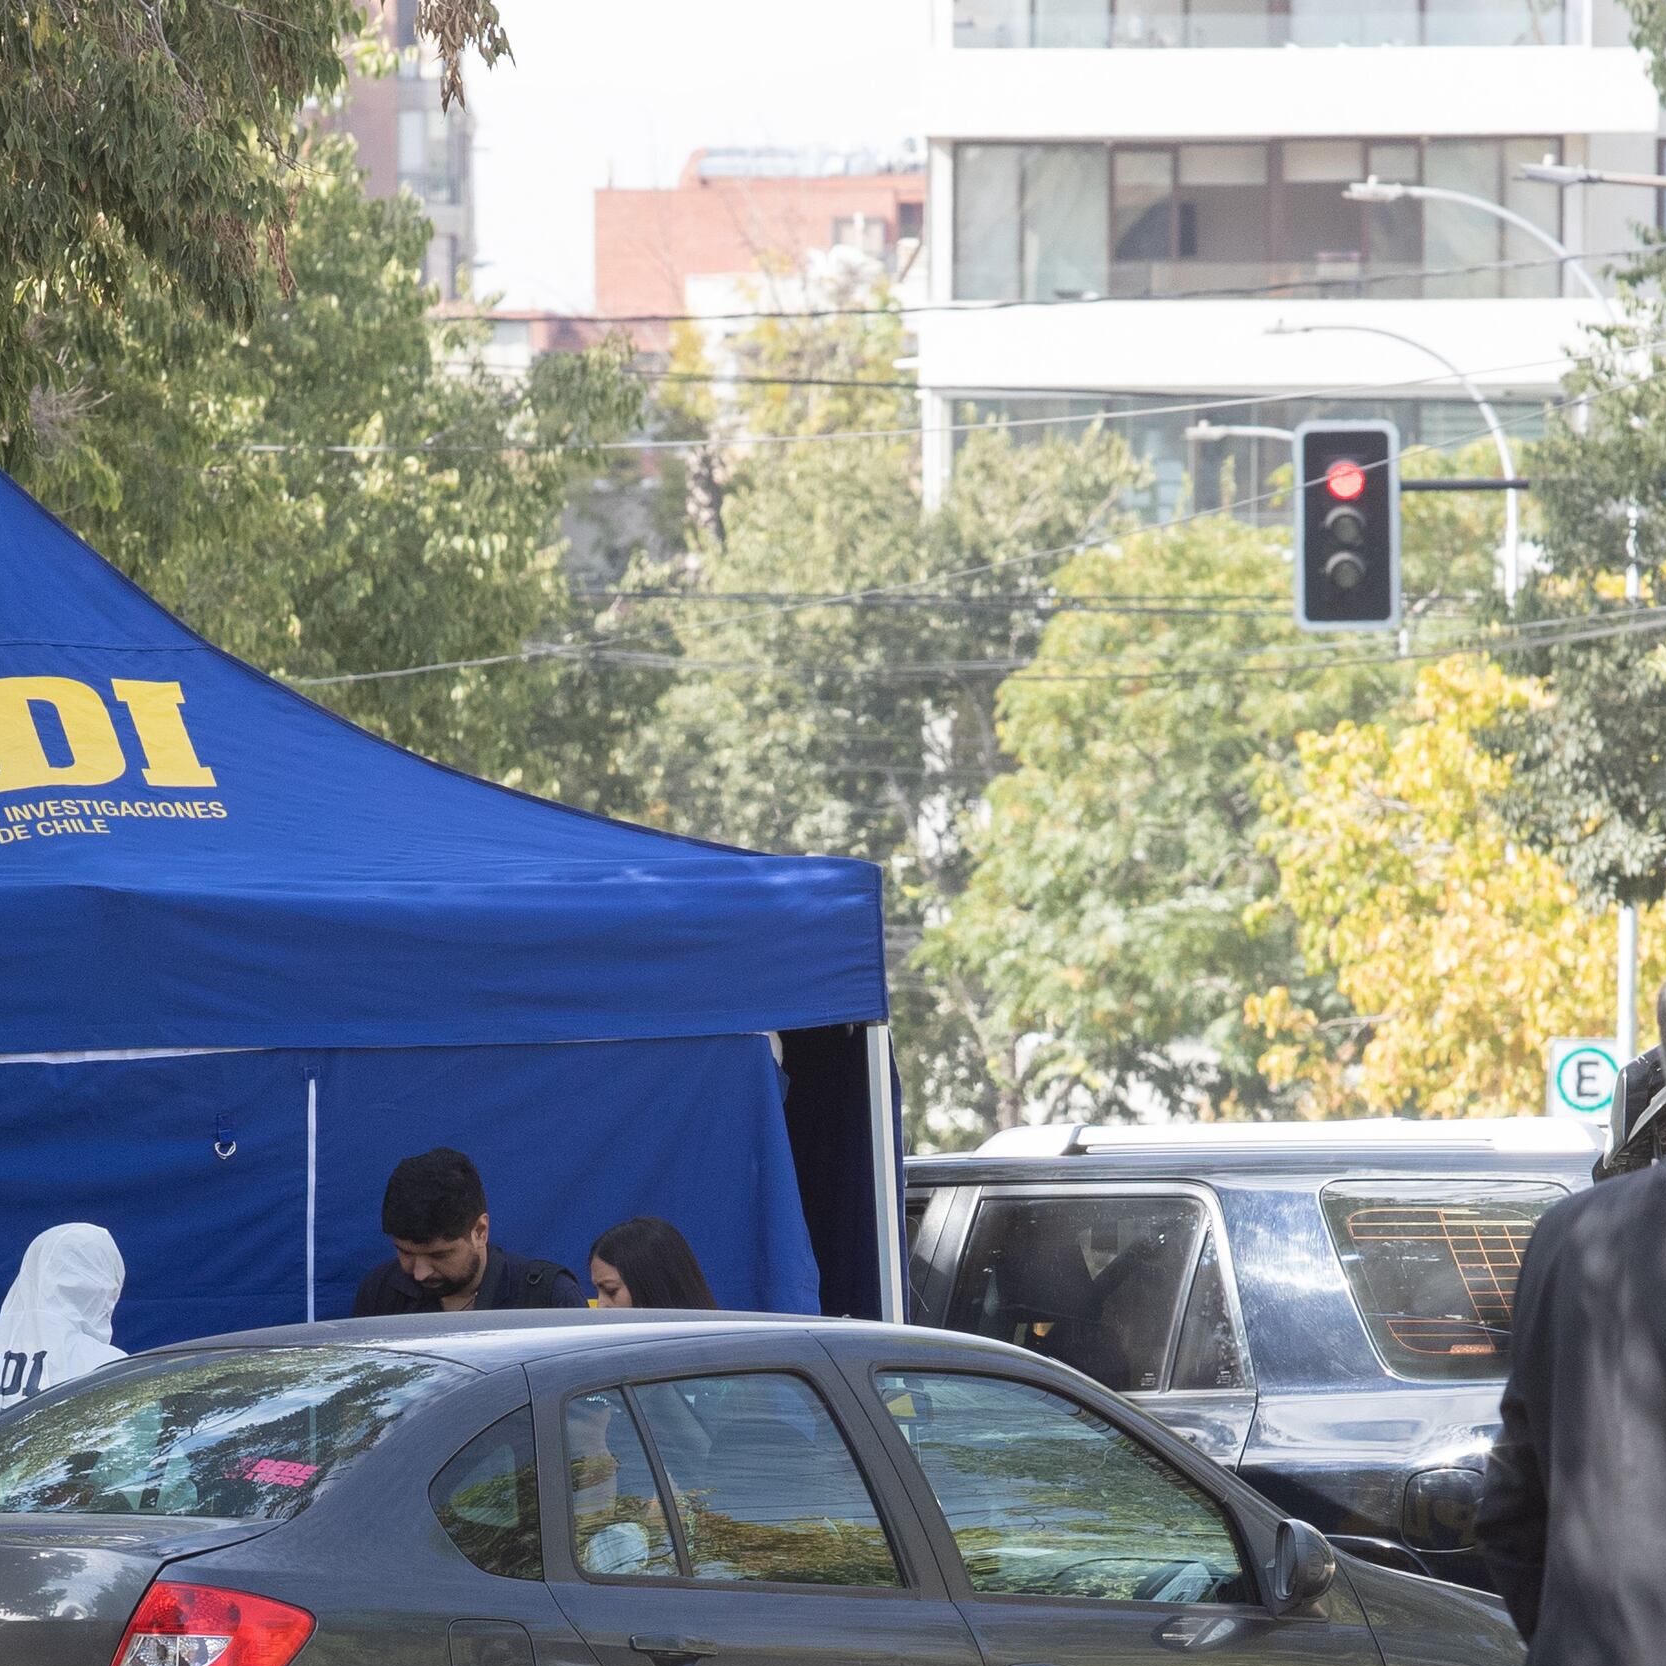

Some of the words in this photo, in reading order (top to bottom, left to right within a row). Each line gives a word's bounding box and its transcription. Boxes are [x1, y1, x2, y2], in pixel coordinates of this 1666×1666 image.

[3, 799, 228, 823] INVESTIGACIONES
[37, 818, 111, 837] CHILE
[1577, 1061, 1600, 1098] E
